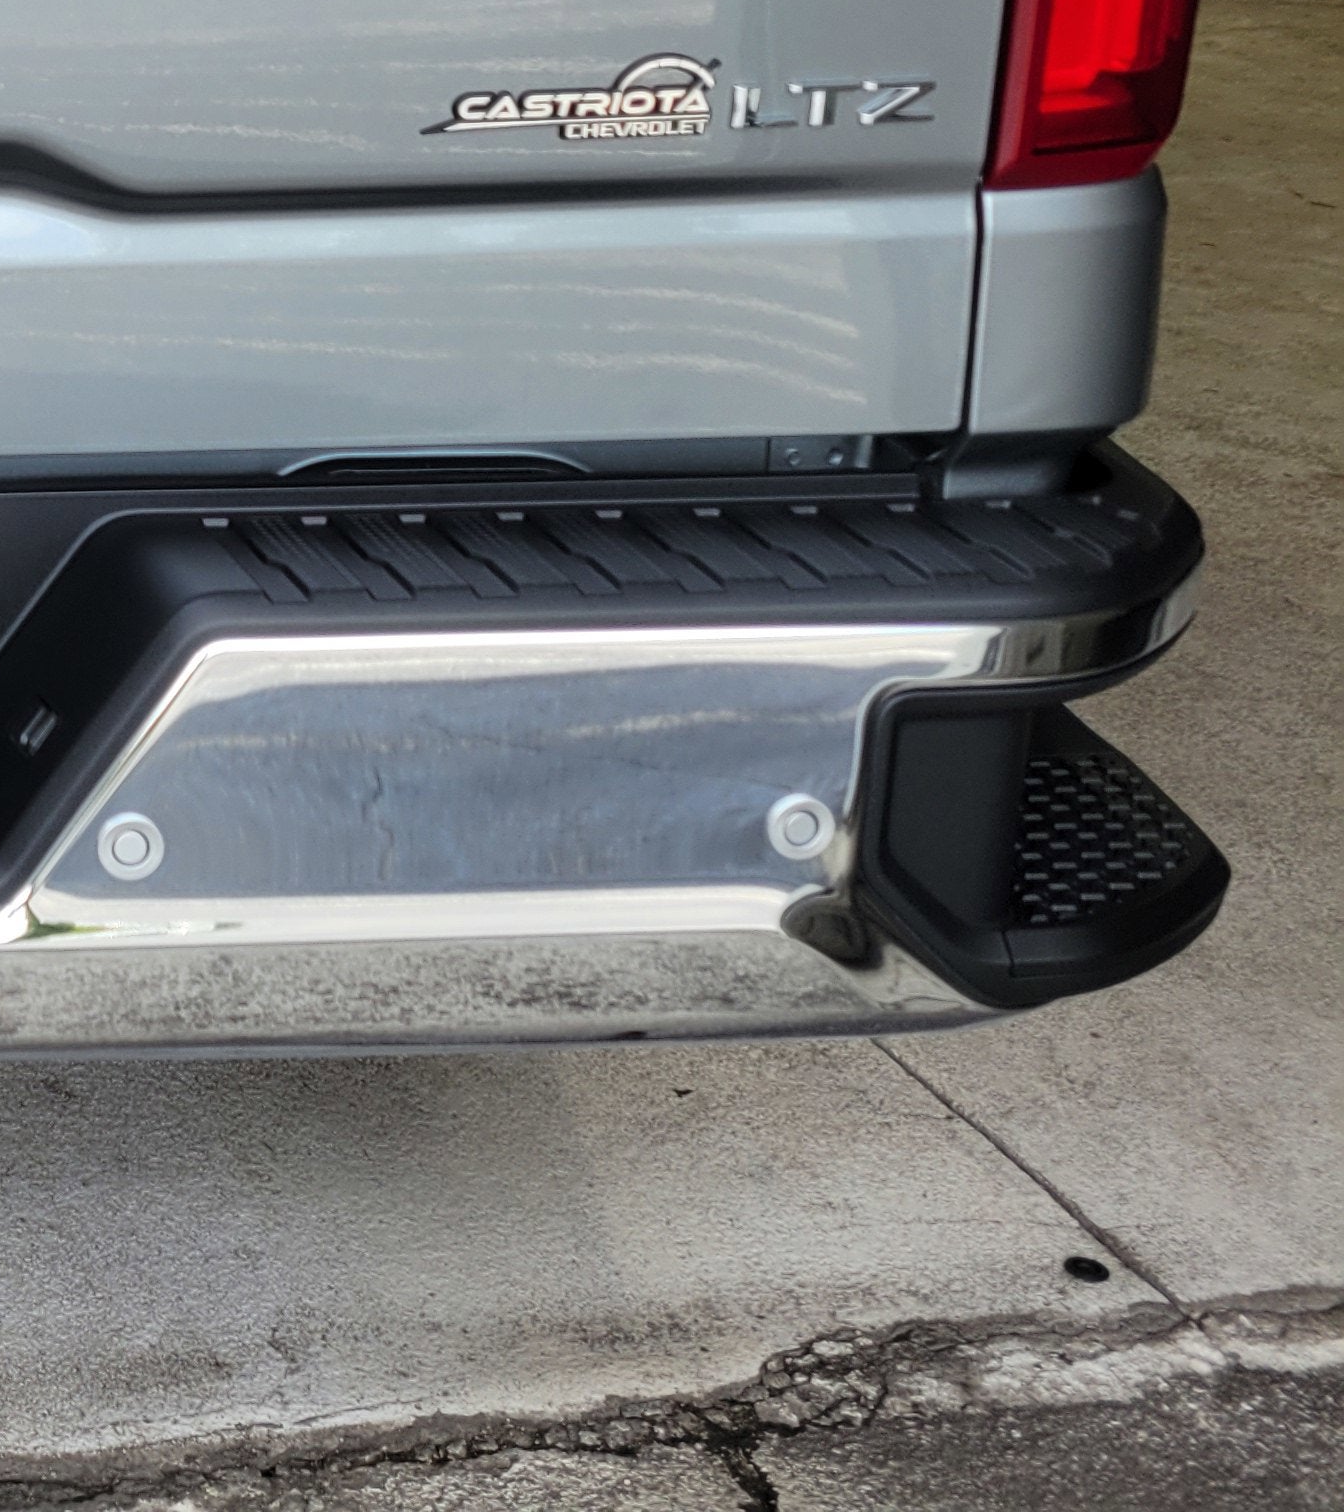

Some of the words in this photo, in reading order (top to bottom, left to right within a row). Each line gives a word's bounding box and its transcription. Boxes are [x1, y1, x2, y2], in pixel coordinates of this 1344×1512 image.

[456, 88, 710, 121] CASTRIOTA
[729, 79, 936, 129] LTZ
[564, 120, 707, 140] CHEVROLET
